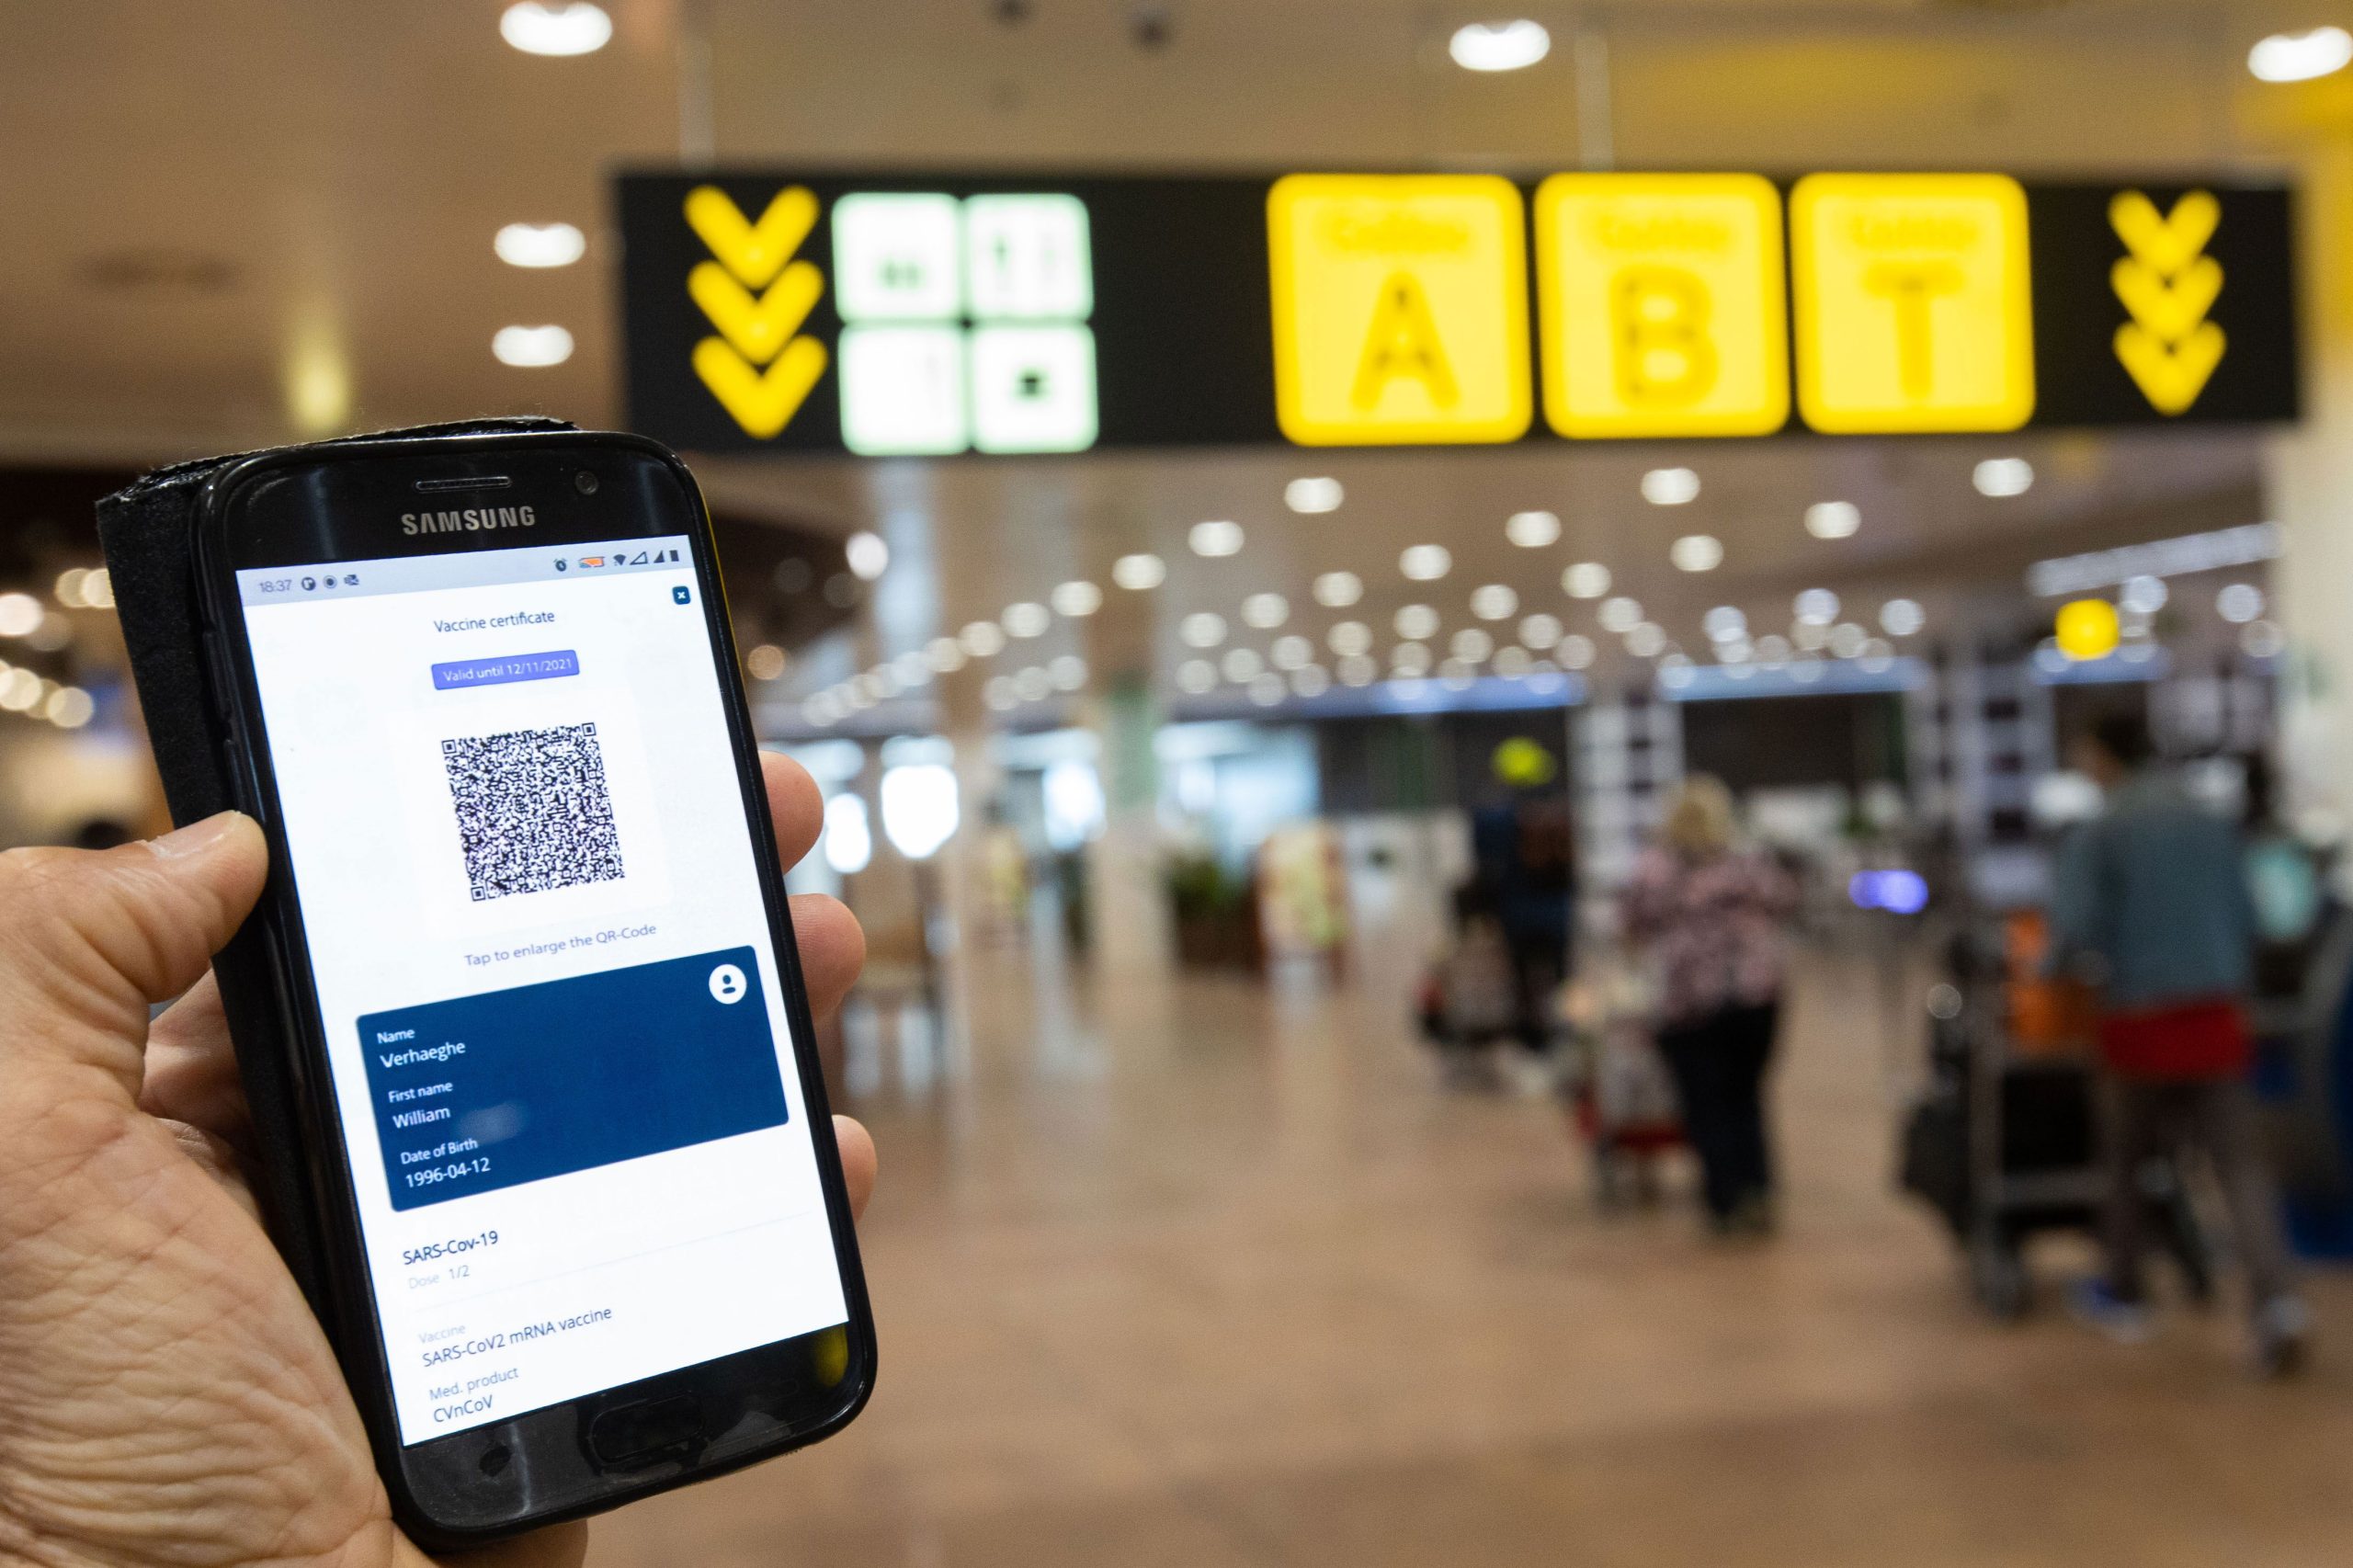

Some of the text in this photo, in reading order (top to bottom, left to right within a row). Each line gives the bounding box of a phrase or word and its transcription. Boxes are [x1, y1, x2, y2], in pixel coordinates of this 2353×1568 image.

[1349, 267, 1462, 414] A
[1607, 263, 1722, 412] B
[1859, 259, 1968, 403] T
[401, 506, 536, 536] SAMSUNG
[259, 579, 293, 593] 18:37
[434, 611, 555, 633] Vaccine certificate
[442, 658, 572, 682] Valid until 12/11/2021
[463, 924, 657, 966] Tap to enlarge the QR-Code
[376, 1028, 415, 1045] Name
[380, 1041, 467, 1069] Verhaeghe
[388, 1082, 454, 1103] First name
[392, 1107, 451, 1130] William
[400, 1137, 479, 1165] Date of Birth
[405, 1156, 492, 1188] 1996-04-12
[403, 1230, 499, 1266] SARS-Cov-19
[408, 1264, 471, 1290] Dose 1/2
[418, 1323, 467, 1345] Vaccine
[422, 1308, 613, 1369] SARS-CoV2 mRNA vaccine
[429, 1367, 520, 1402] Med. product
[433, 1394, 494, 1424] CVnCoV
